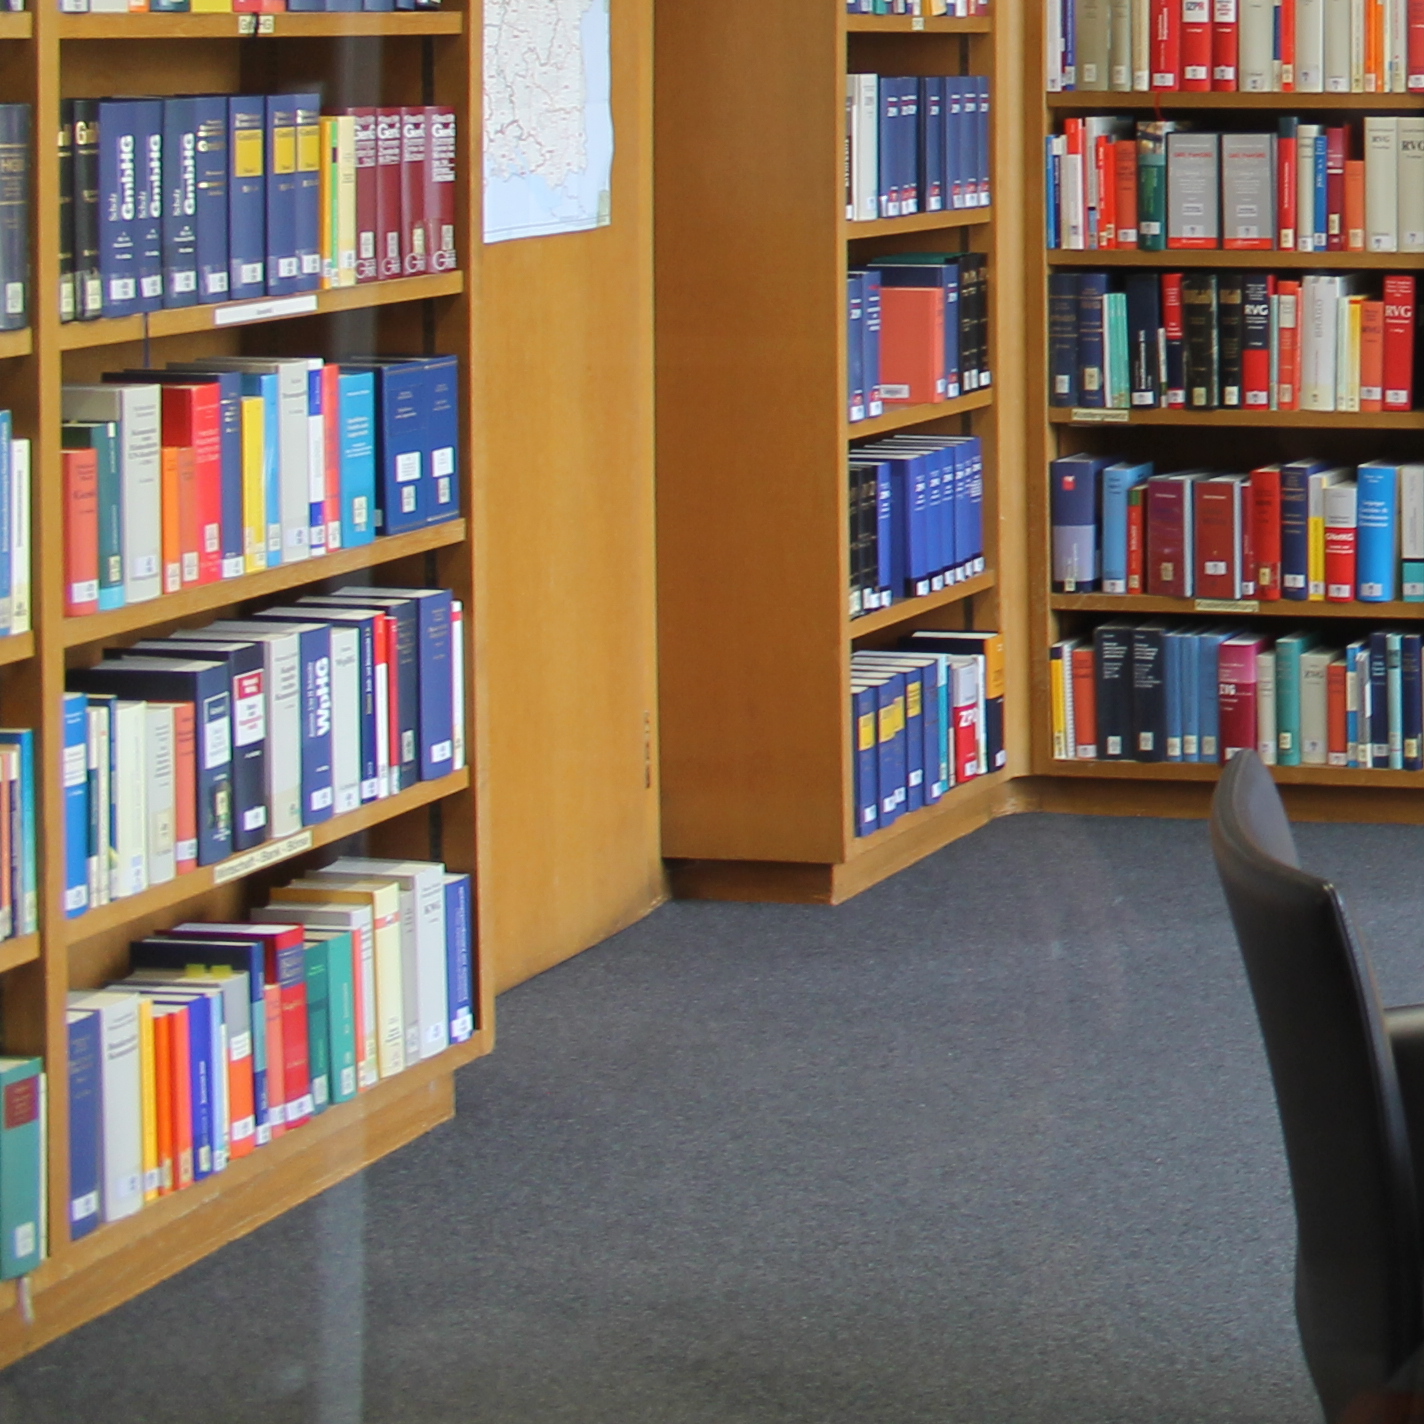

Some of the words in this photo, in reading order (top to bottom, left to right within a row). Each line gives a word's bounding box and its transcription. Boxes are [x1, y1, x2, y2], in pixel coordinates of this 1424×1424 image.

[120, 135, 135, 220] GmbHG
[149, 133, 162, 218] GmbHG
[183, 132, 196, 216] GmbHG
[1244, 304, 1269, 316] RVG
[1385, 305, 1413, 317] RVG
